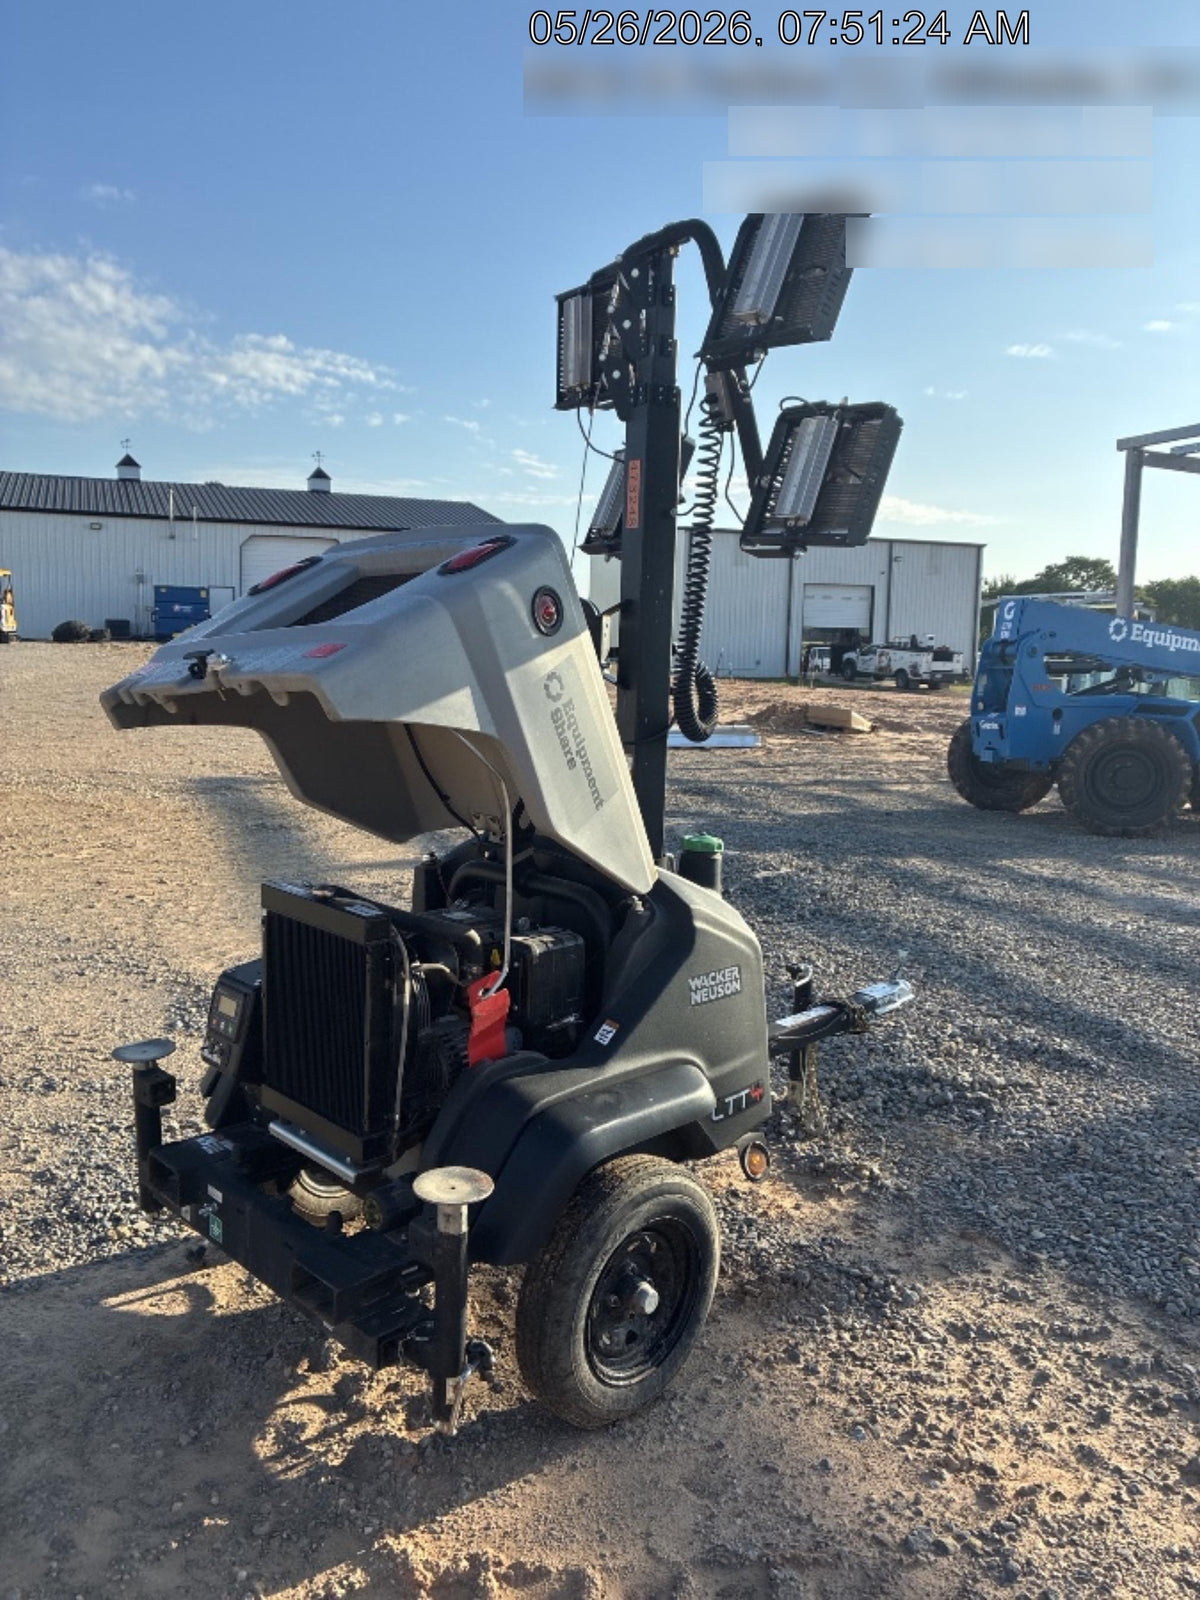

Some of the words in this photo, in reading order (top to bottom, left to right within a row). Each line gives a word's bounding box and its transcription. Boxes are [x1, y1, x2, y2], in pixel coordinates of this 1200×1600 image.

[1130, 623, 1200, 651] Equipm
[551, 707, 577, 771] Share
[562, 698, 604, 811] Equipment
[688, 966, 740, 991] WACKER
[690, 982, 741, 1006] NEUSON
